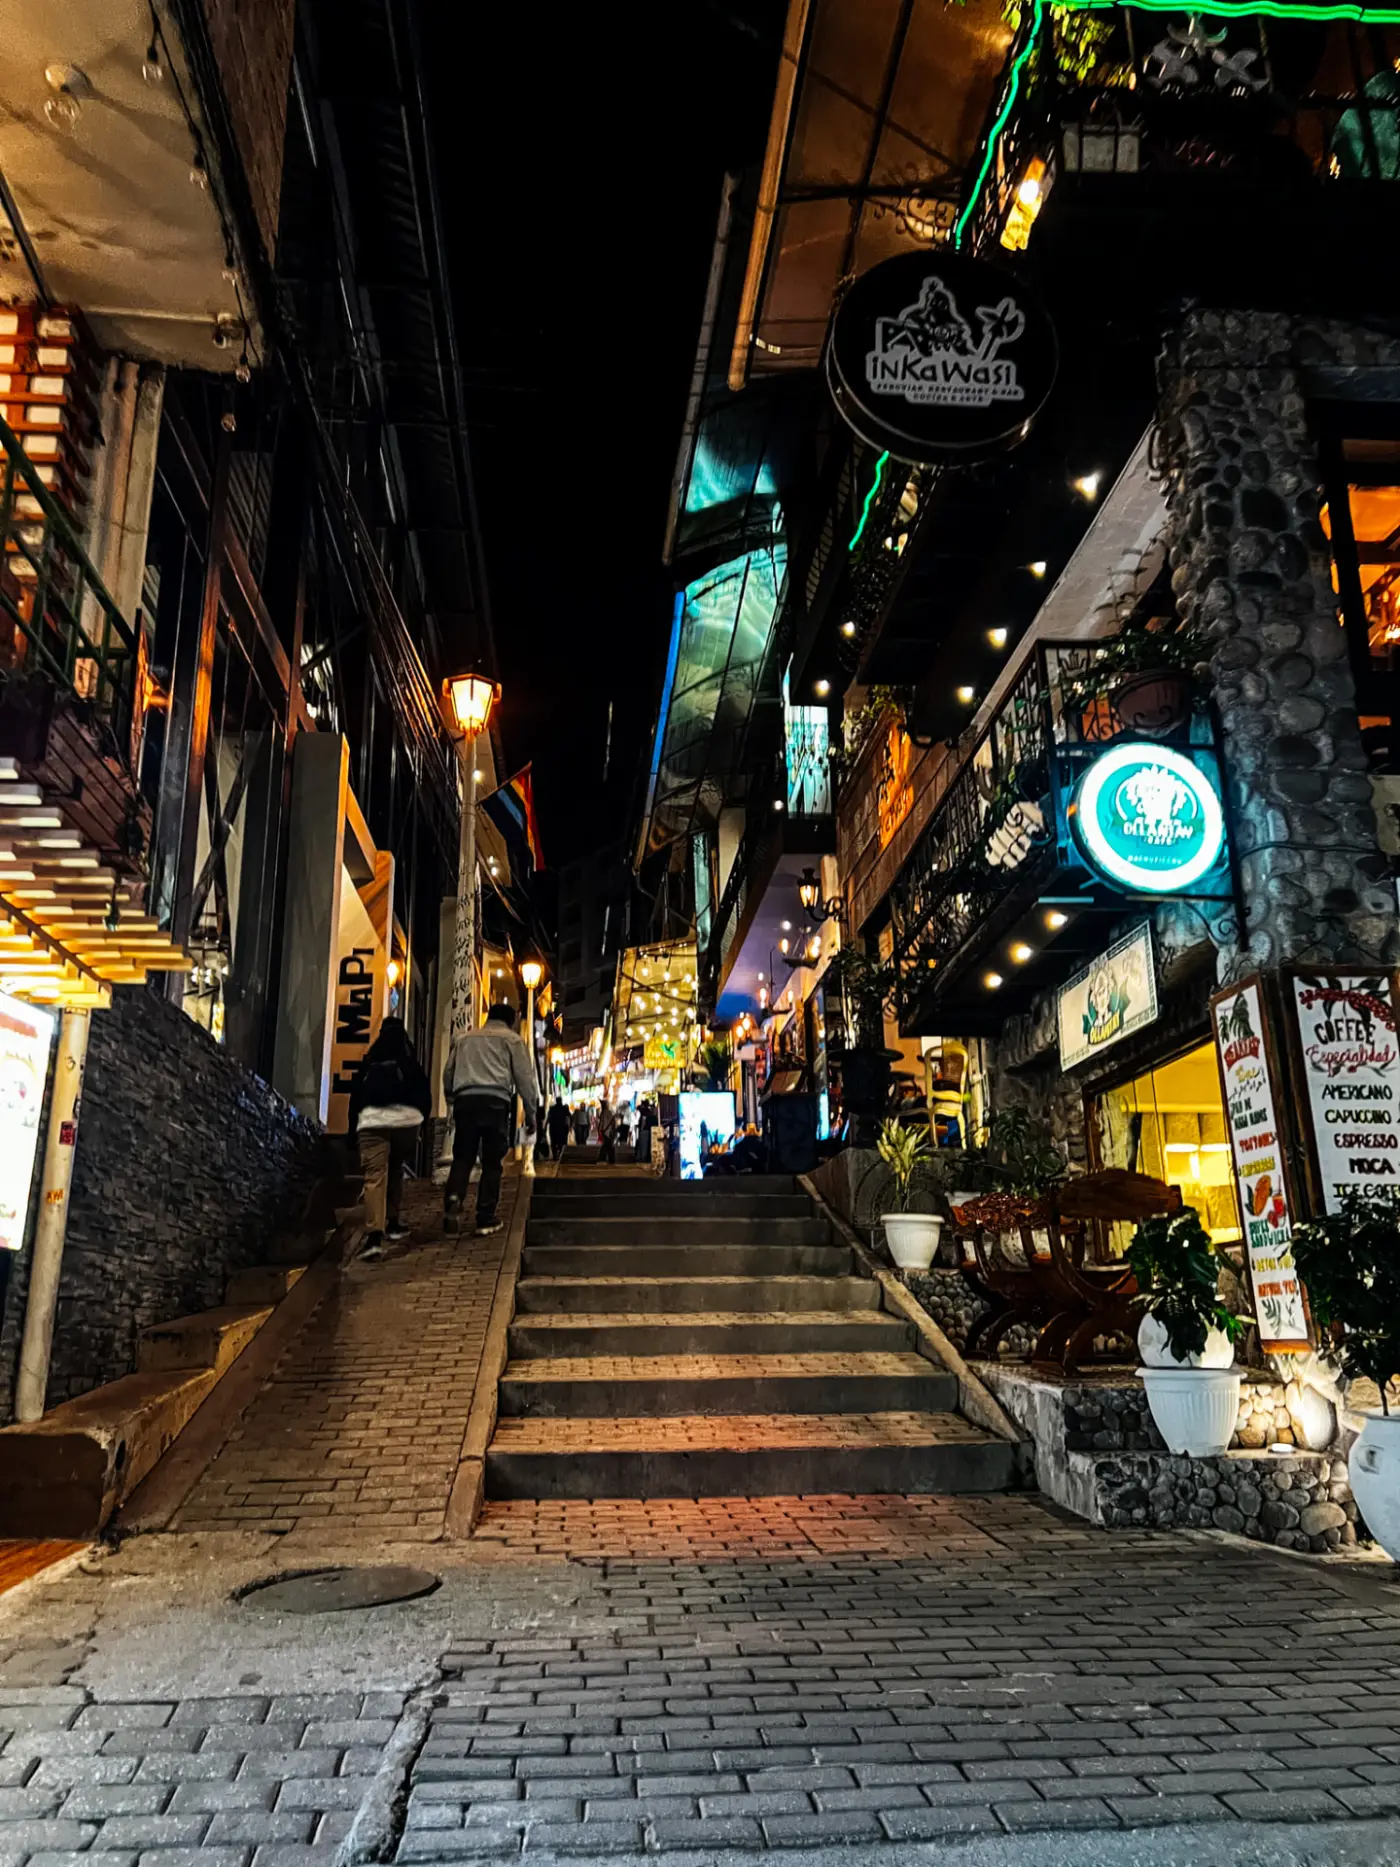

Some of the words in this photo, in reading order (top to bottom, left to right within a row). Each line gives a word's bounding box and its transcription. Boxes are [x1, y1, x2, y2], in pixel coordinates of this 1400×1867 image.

[336, 948, 375, 1043] MAPI
[1314, 1018, 1376, 1046] COFFEE
[1322, 1084, 1393, 1100] AMERICANO
[1324, 1109, 1392, 1124] CAPUCCINO
[1334, 1133, 1398, 1149] ESPRESSO
[1348, 1157, 1396, 1175] MOCA
[1332, 1182, 1361, 1199] ICE
